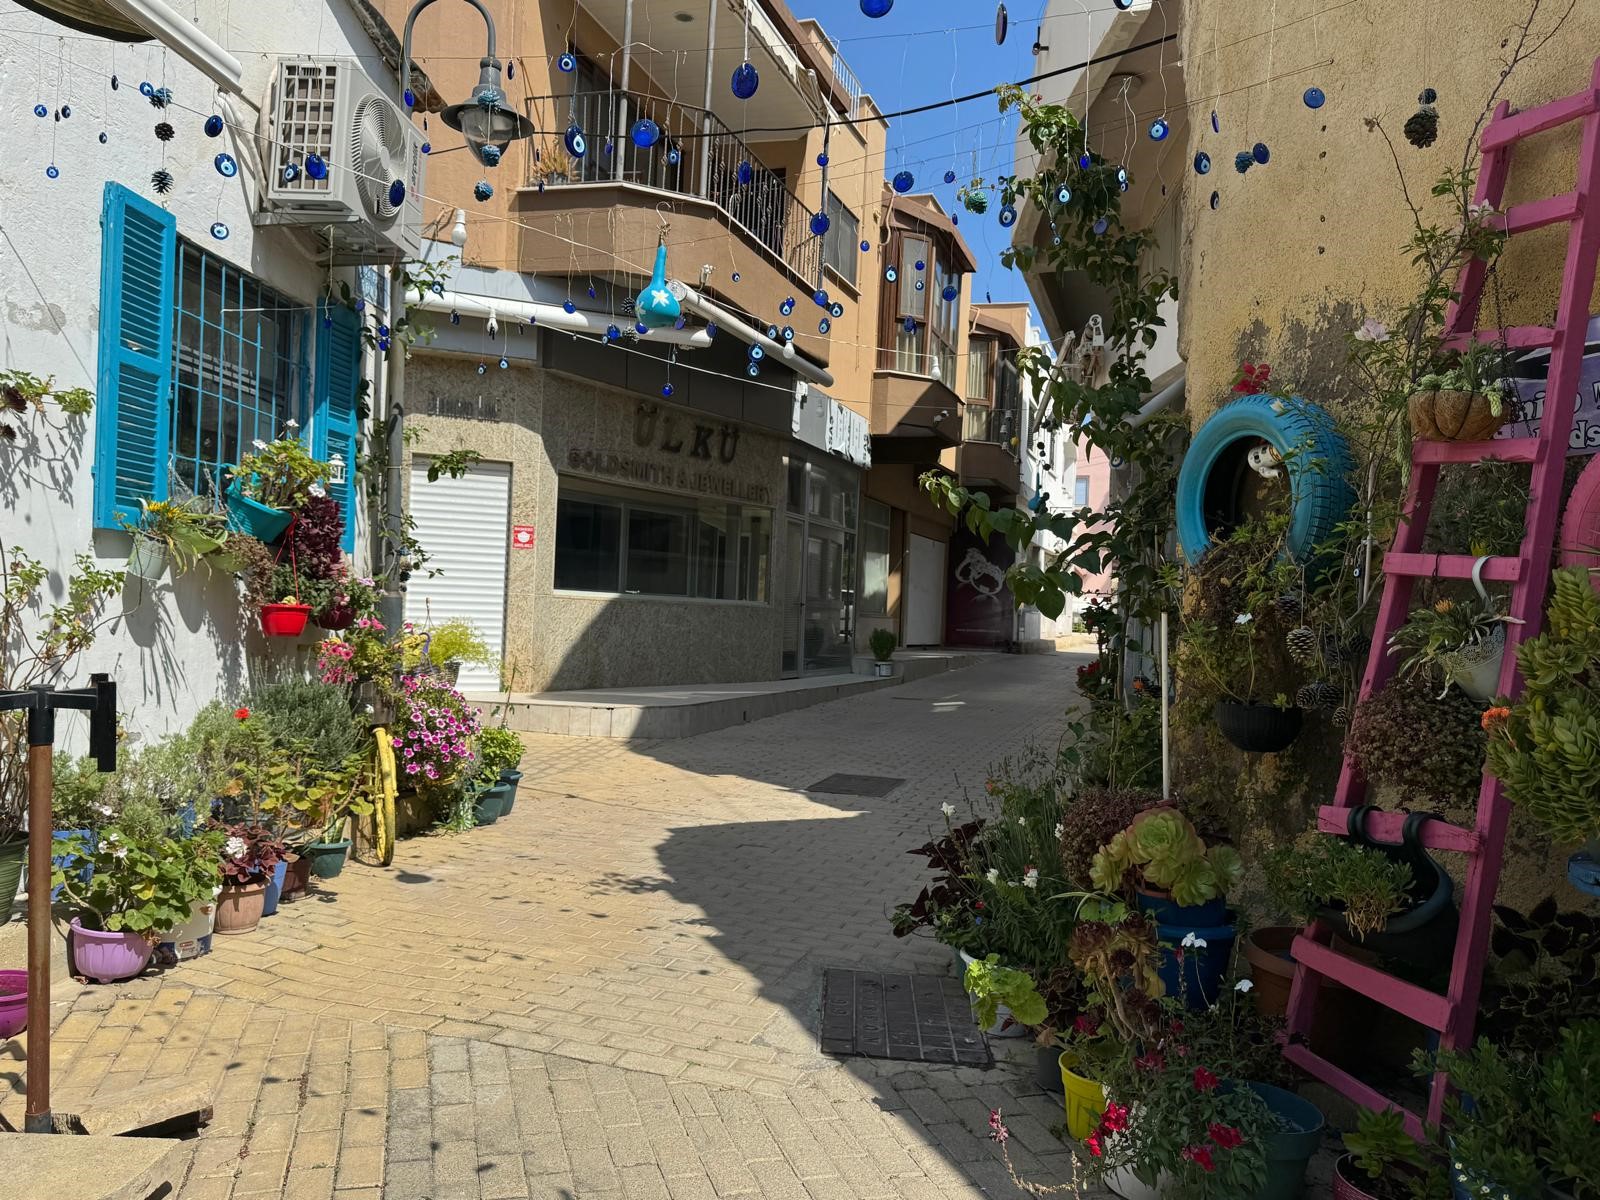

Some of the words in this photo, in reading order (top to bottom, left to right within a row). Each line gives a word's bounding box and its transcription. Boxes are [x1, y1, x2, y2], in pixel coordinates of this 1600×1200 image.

[632, 401, 740, 464] ÜLKÜ
[568, 448, 673, 485] GOLDSMITH
[676, 472, 691, 489] &
